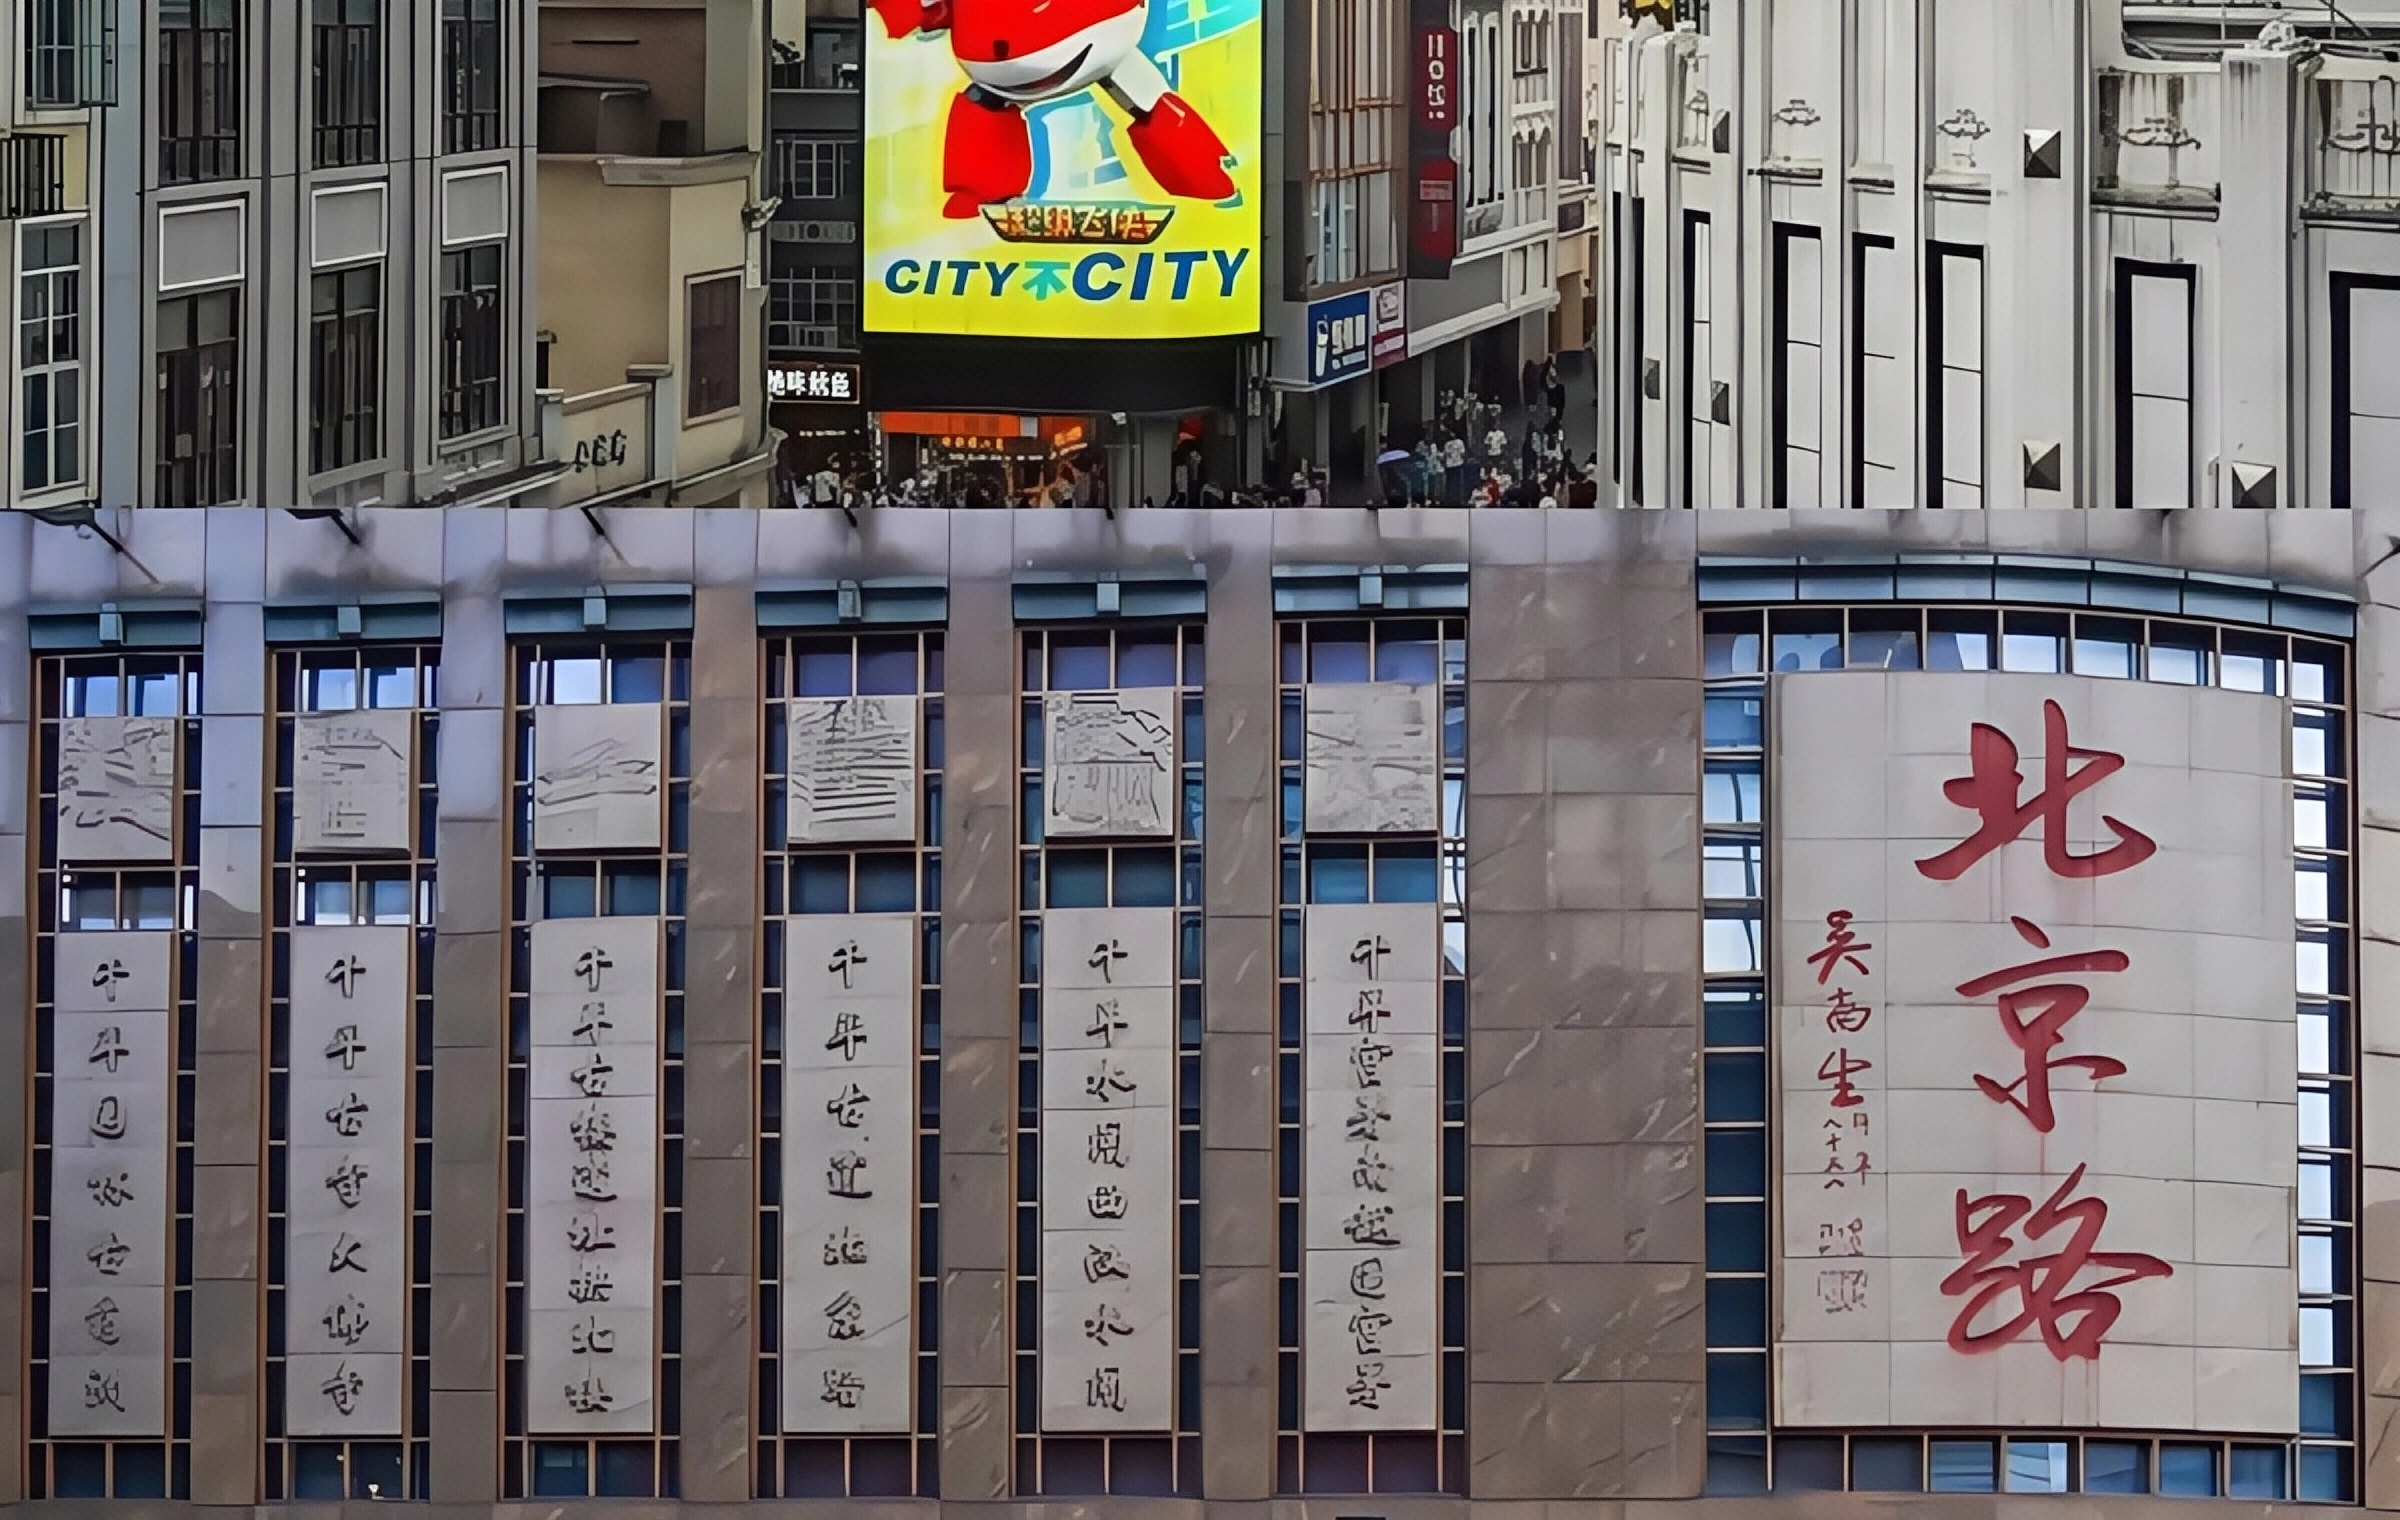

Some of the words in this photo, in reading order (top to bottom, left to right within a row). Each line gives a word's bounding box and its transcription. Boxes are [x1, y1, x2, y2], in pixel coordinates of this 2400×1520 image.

[884, 248, 1250, 301] CITY不CITY
[1914, 698, 2174, 1363] 北京路
